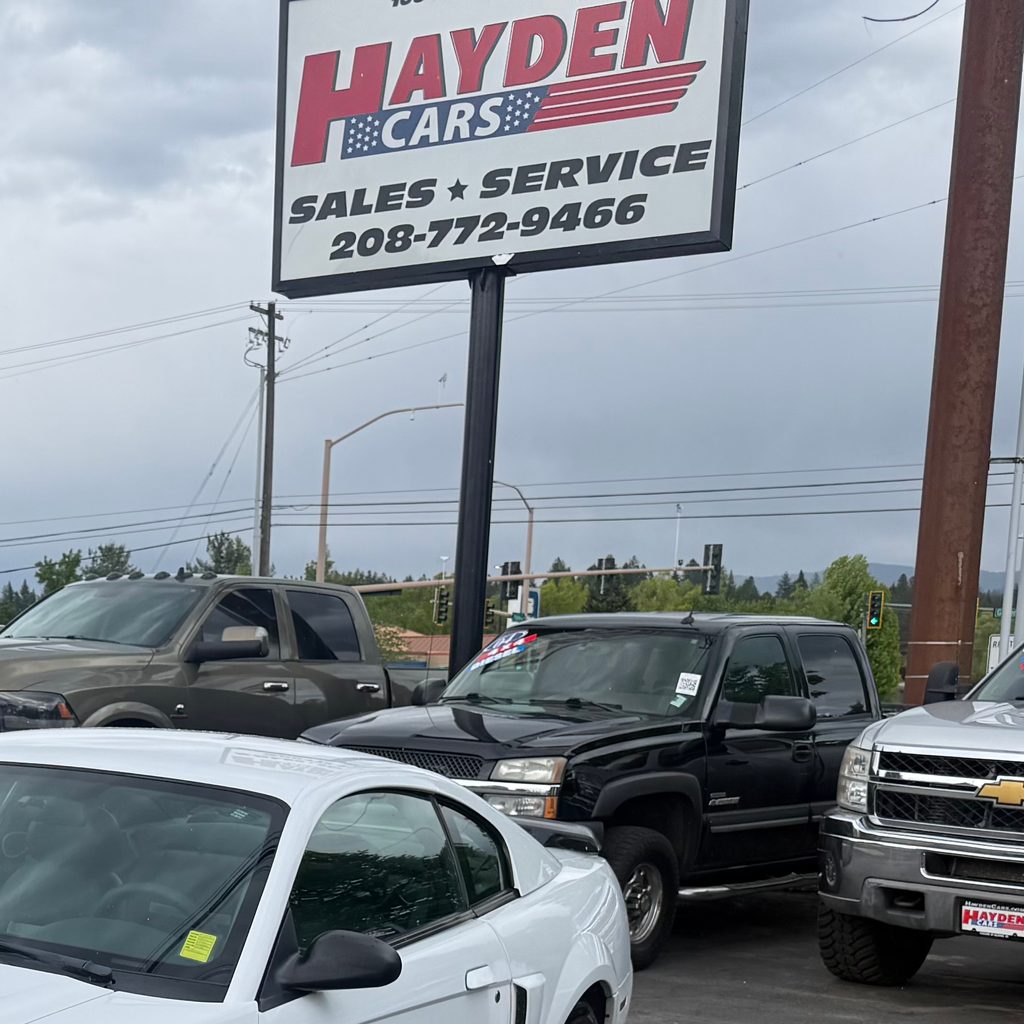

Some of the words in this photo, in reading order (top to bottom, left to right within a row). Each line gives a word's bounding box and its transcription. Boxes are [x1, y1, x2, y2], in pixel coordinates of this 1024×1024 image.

[291, 0, 696, 167] HAYDEN
[379, 96, 504, 148] CARS
[288, 178, 438, 224] SALES
[479, 139, 712, 199] SERVICE
[329, 194, 648, 260] 208-772-9466
